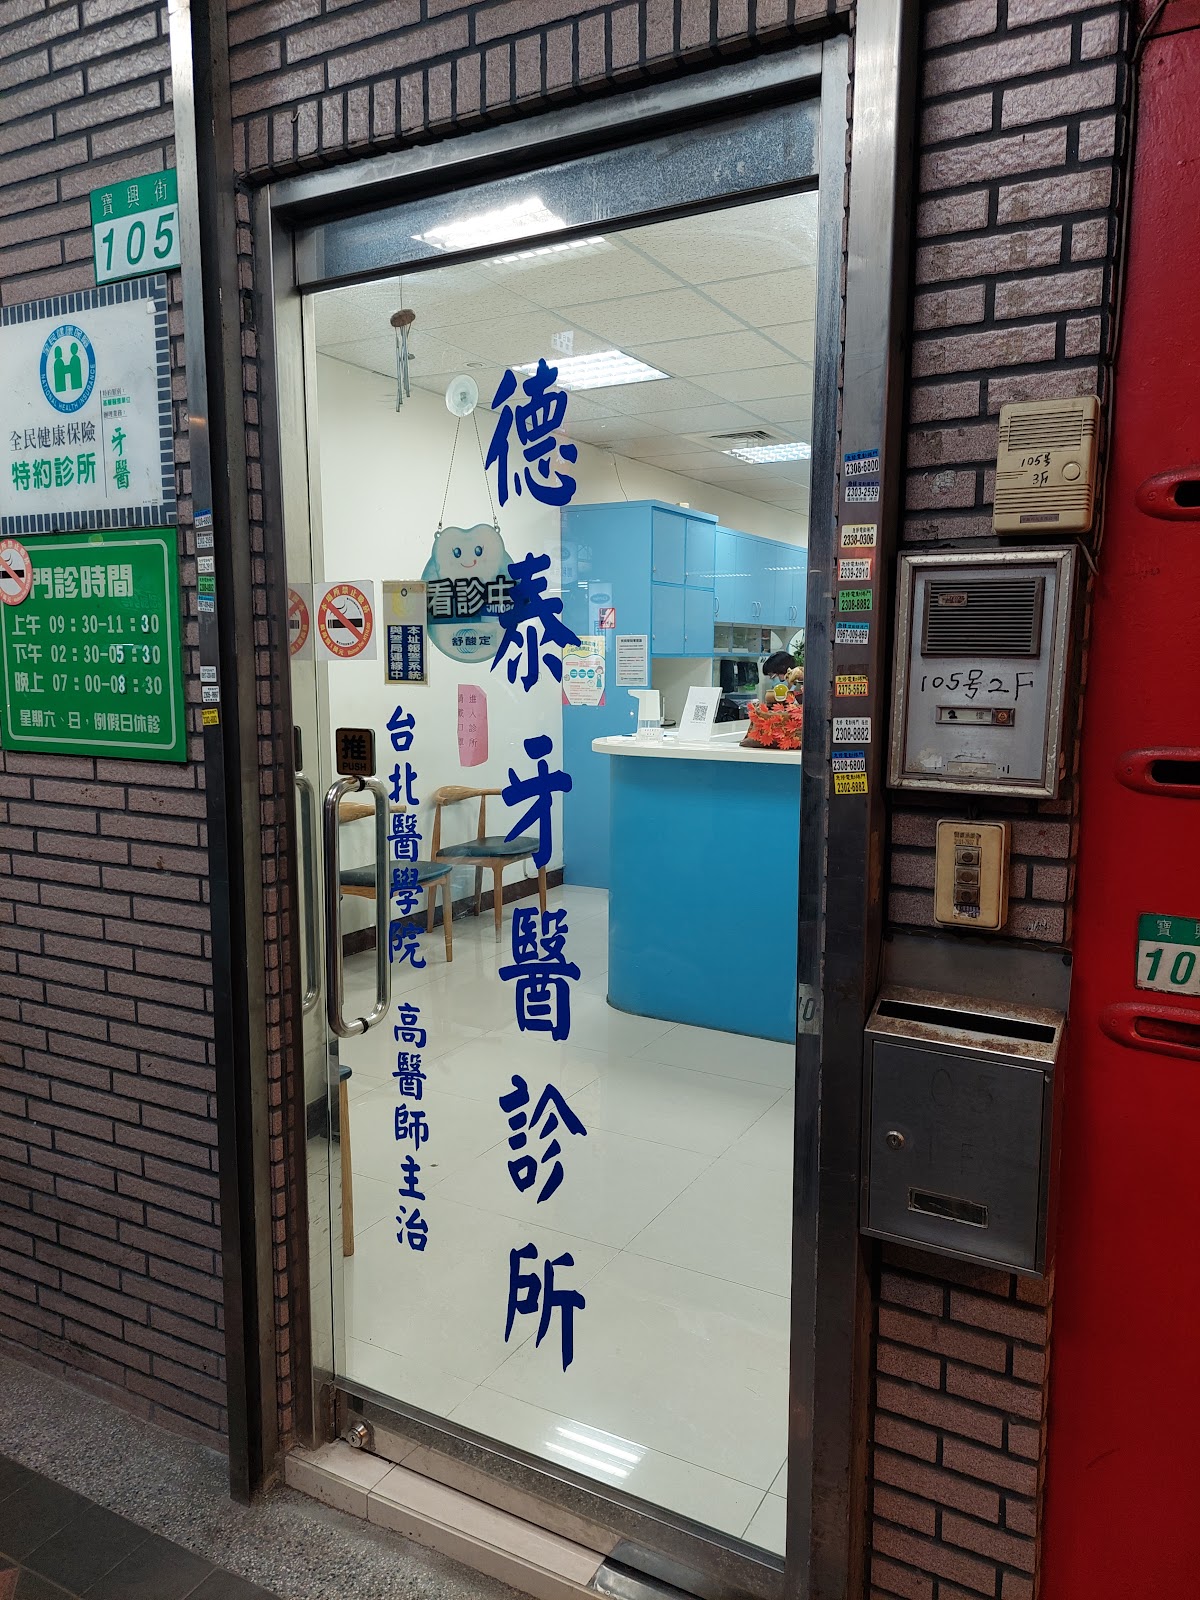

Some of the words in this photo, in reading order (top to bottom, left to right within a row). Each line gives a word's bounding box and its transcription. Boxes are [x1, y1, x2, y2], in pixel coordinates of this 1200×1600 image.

[101, 178, 168, 217] 寶興街
[102, 211, 175, 271] 105
[10, 421, 96, 451] 全民健康保險
[11, 452, 96, 491] 特約診所
[111, 427, 131, 490] 牙醫
[843, 534, 874, 546] 2338-0306
[30, 564, 134, 599] 門診時間
[840, 567, 869, 578] 2339-2910
[427, 576, 516, 618] 看診中
[12, 614, 41, 635] 上午
[451, 635, 491, 647] 舒酸定
[13, 644, 43, 664] 下午
[389, 625, 404, 680] 與警局連線中
[407, 625, 422, 680] 本址報警系統
[14, 672, 45, 693] 晚上
[341, 734, 367, 761] 推
[342, 762, 367, 772] PUSH
[386, 705, 427, 969] 台北醫學院
[484, 358, 588, 1373] 德泰牙醫診所
[392, 1002, 430, 1252] 高醫師主治
